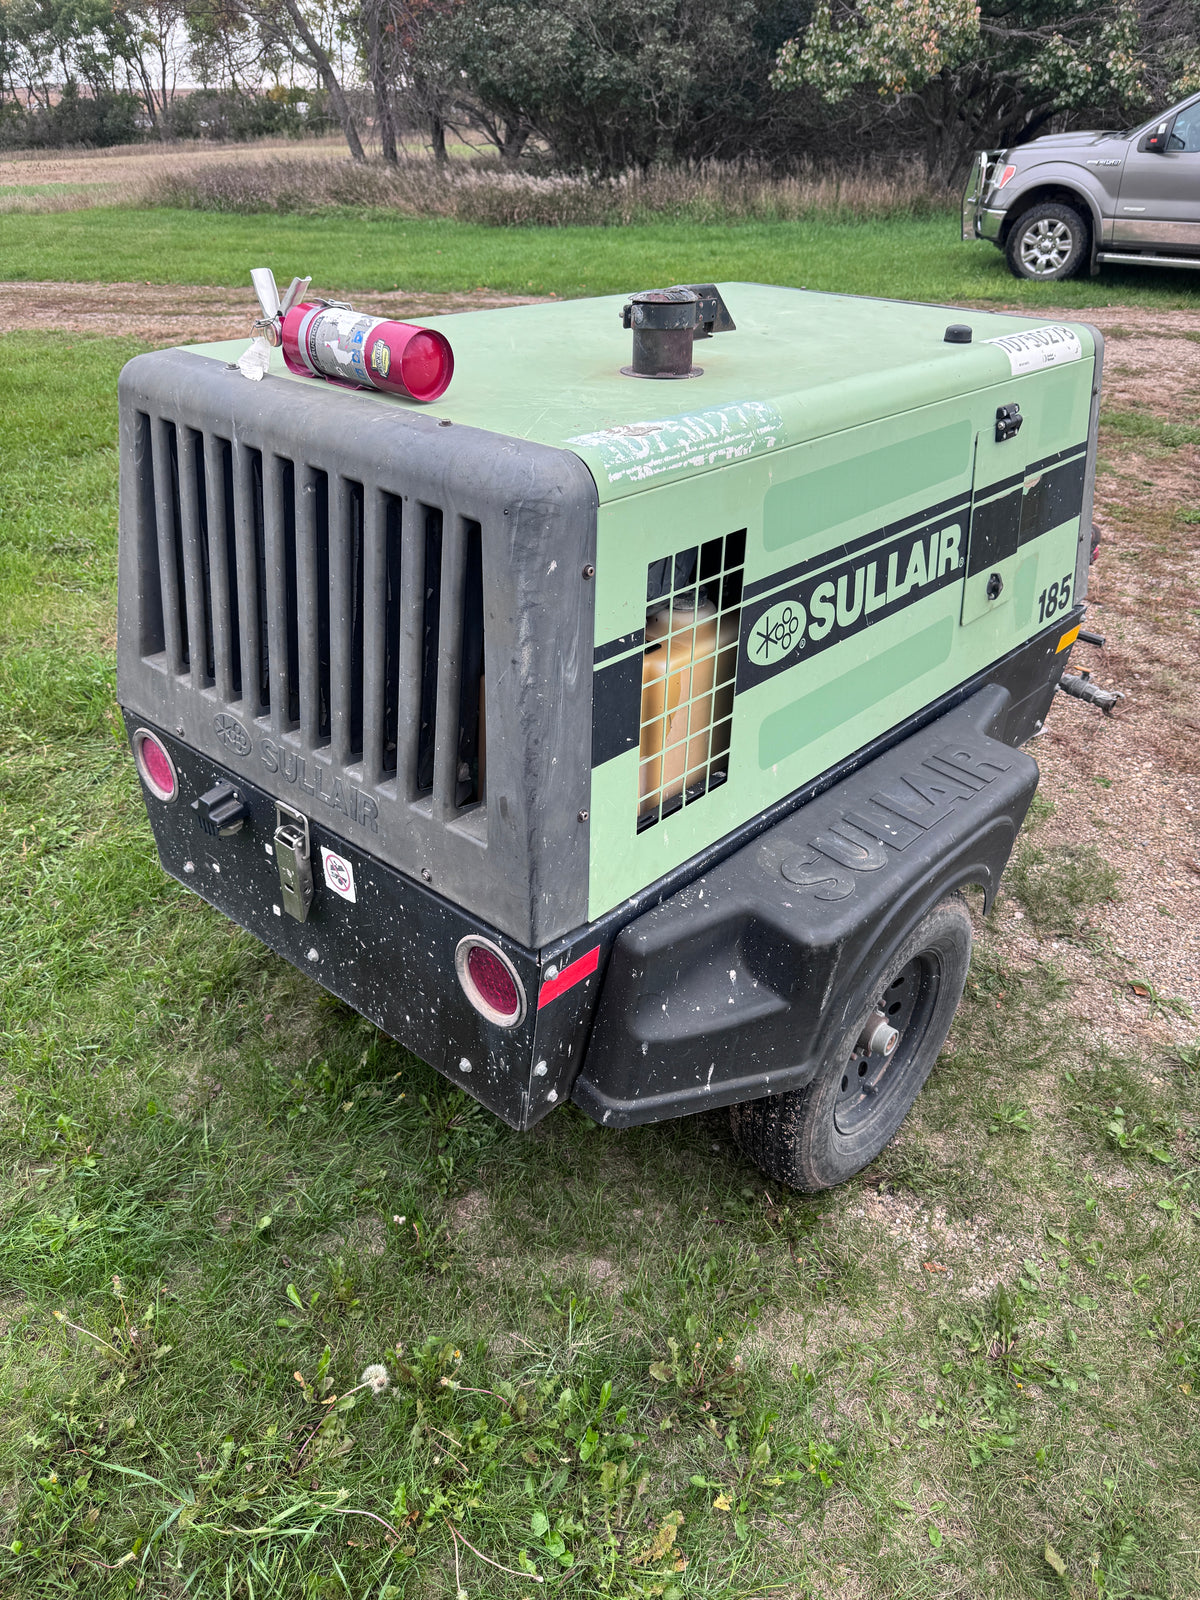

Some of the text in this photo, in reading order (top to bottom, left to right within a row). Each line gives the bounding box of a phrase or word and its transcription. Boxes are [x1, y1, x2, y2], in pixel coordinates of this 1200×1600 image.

[989, 326, 1074, 354] 10750278
[808, 523, 962, 641] SULLAIR
[1038, 572, 1072, 623] 185
[261, 738, 379, 834] SULLAIR
[780, 745, 1012, 901] SULLAIR
